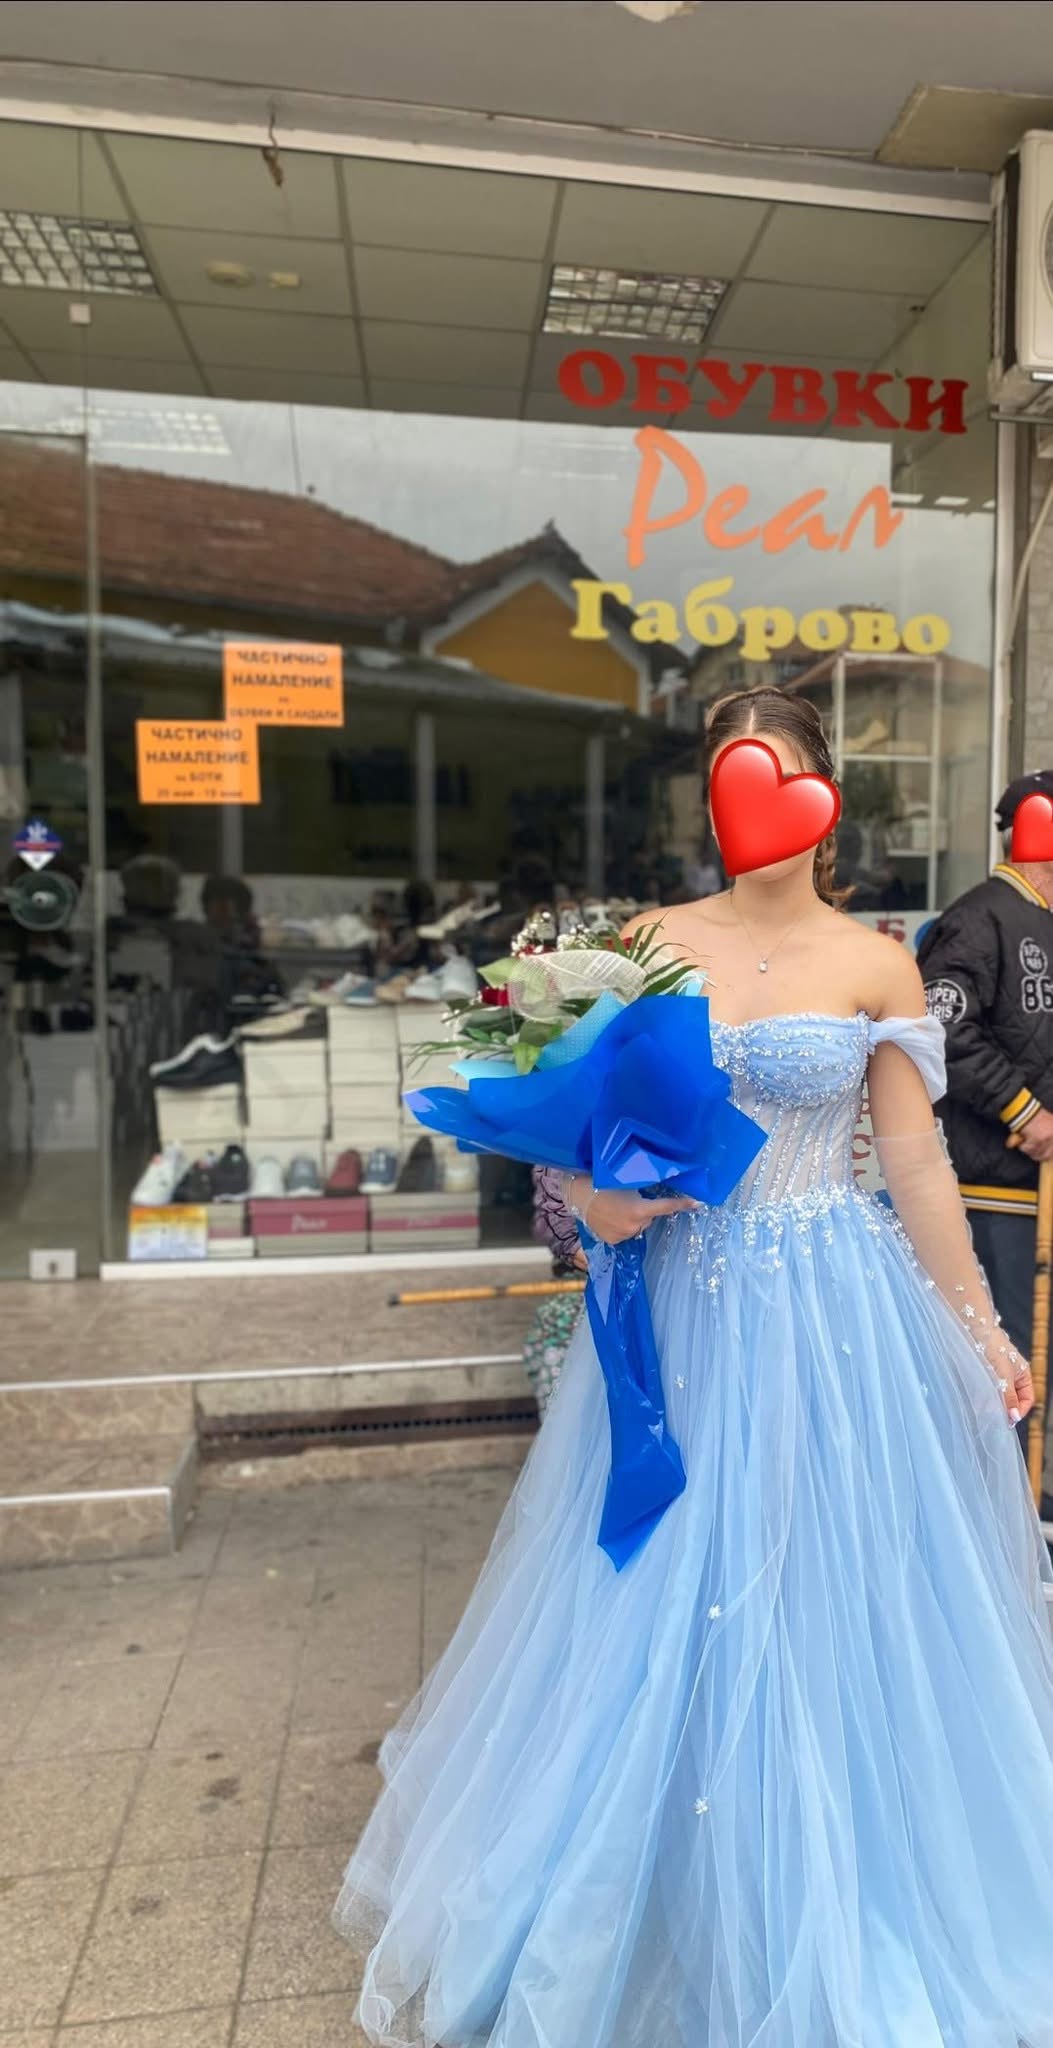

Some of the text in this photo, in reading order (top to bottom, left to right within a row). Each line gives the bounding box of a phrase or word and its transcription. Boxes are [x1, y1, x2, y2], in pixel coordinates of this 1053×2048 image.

[557, 348, 969, 434] ОБУВКИ
[623, 424, 904, 570] Реал
[570, 576, 951, 661] Габрово
[237, 651, 327, 665] ЧАСТИЧНО
[233, 673, 334, 688] НАМАЛЕНИЕ
[151, 727, 243, 741] ЧАСТИЧНО
[146, 750, 249, 764] НАМАЛЕНИЕ
